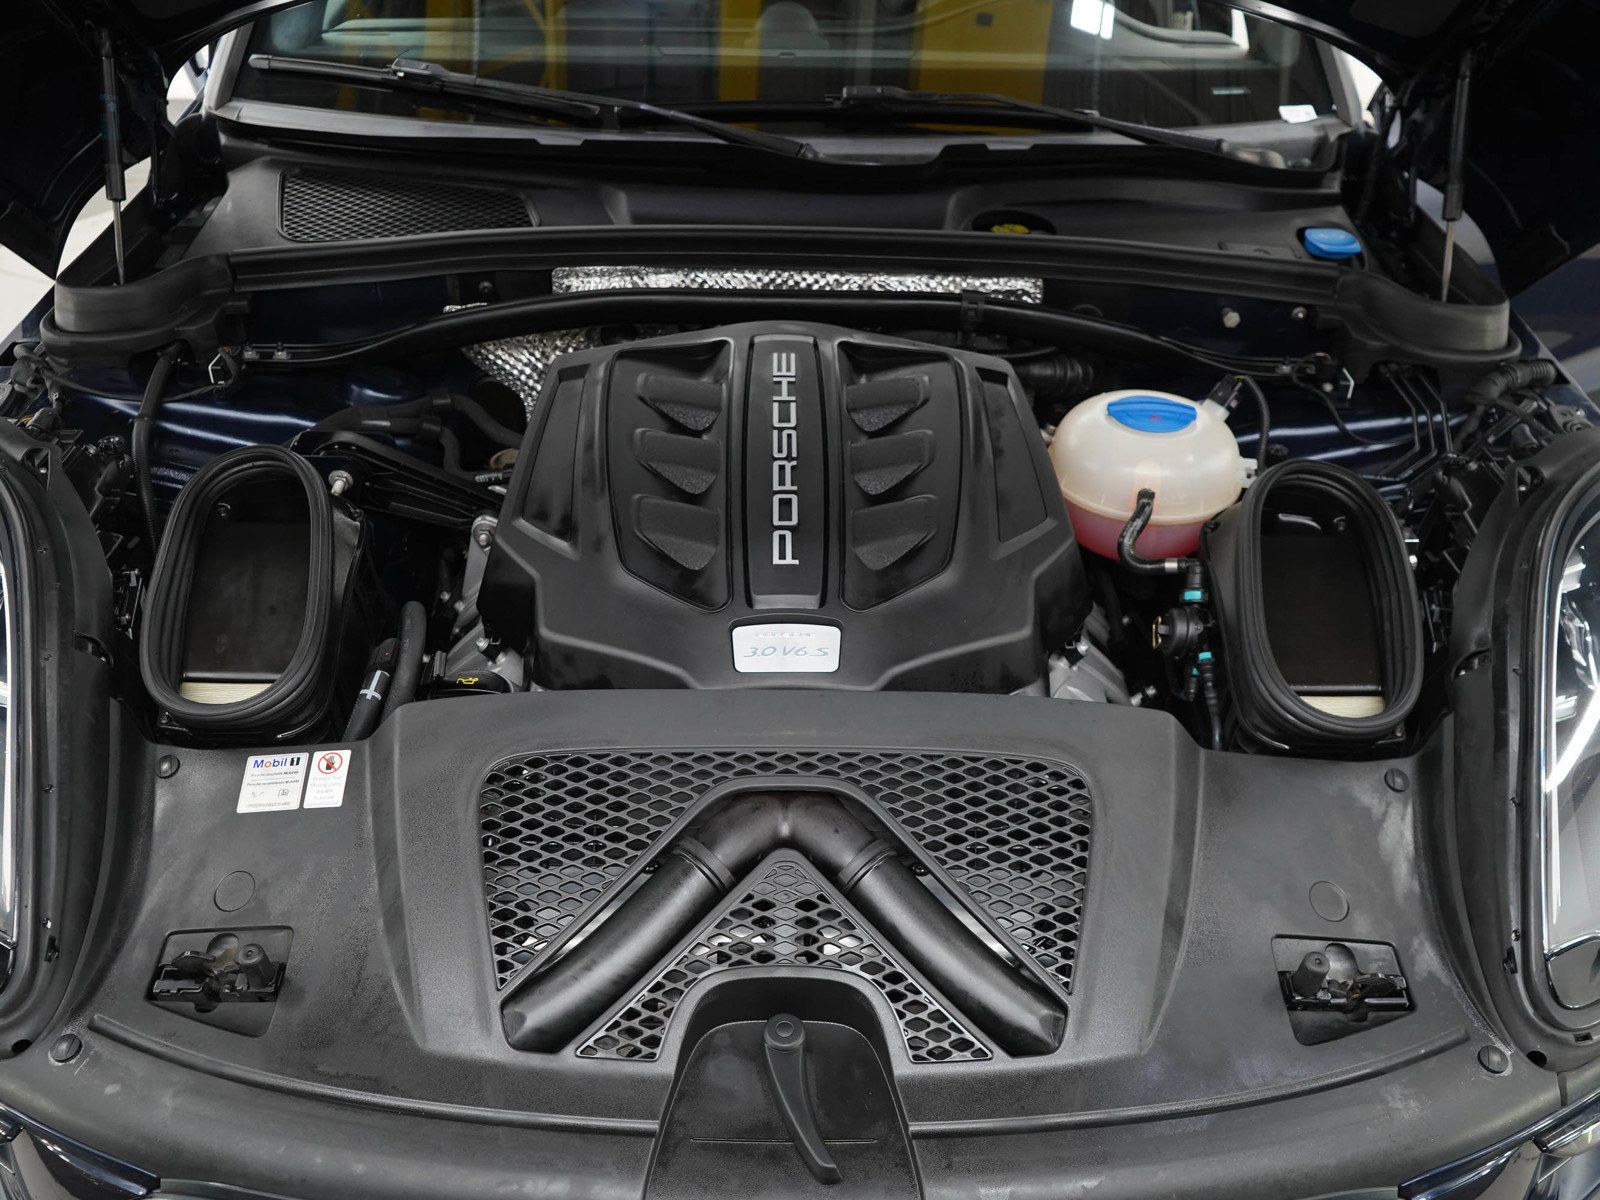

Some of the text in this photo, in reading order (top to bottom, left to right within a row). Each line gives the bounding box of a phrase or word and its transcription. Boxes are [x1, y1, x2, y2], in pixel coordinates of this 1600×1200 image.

[772, 352, 800, 566] PORSCHE
[744, 645, 832, 658] 3.0 V6 S
[252, 757, 301, 769] Mobil 1
